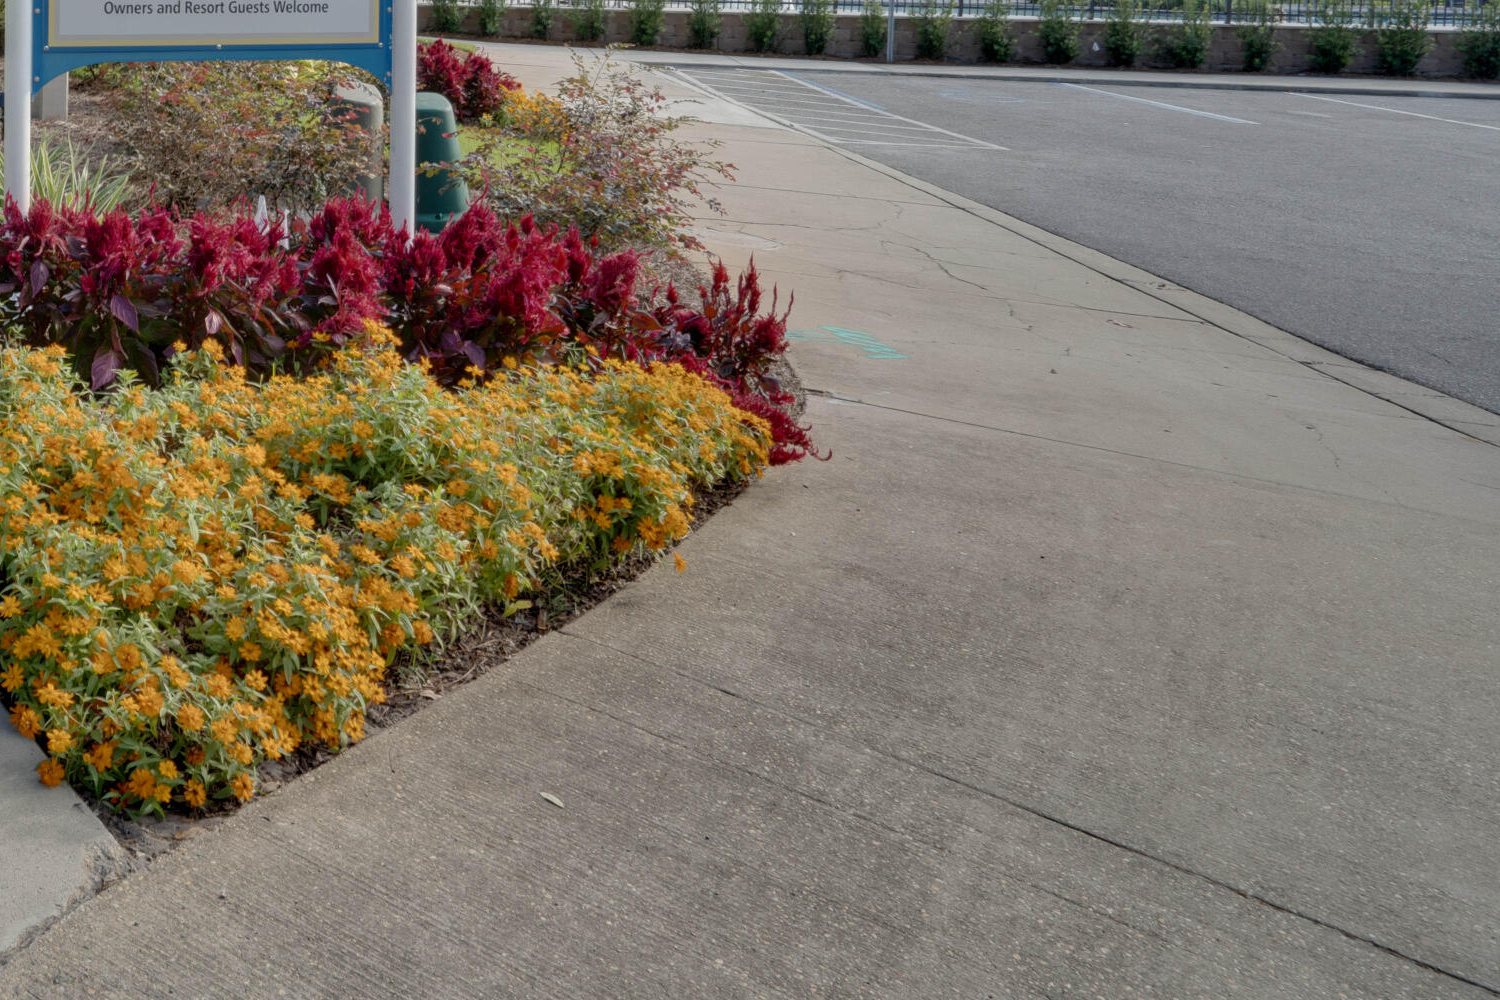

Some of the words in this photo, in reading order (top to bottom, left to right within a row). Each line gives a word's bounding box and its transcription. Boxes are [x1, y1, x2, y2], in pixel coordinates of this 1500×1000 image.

[103, 1, 154, 15] Owners
[156, 0, 182, 14] and
[184, 0, 225, 14] Resort
[228, 0, 271, 14] Guests
[273, 0, 329, 14] Welcome
